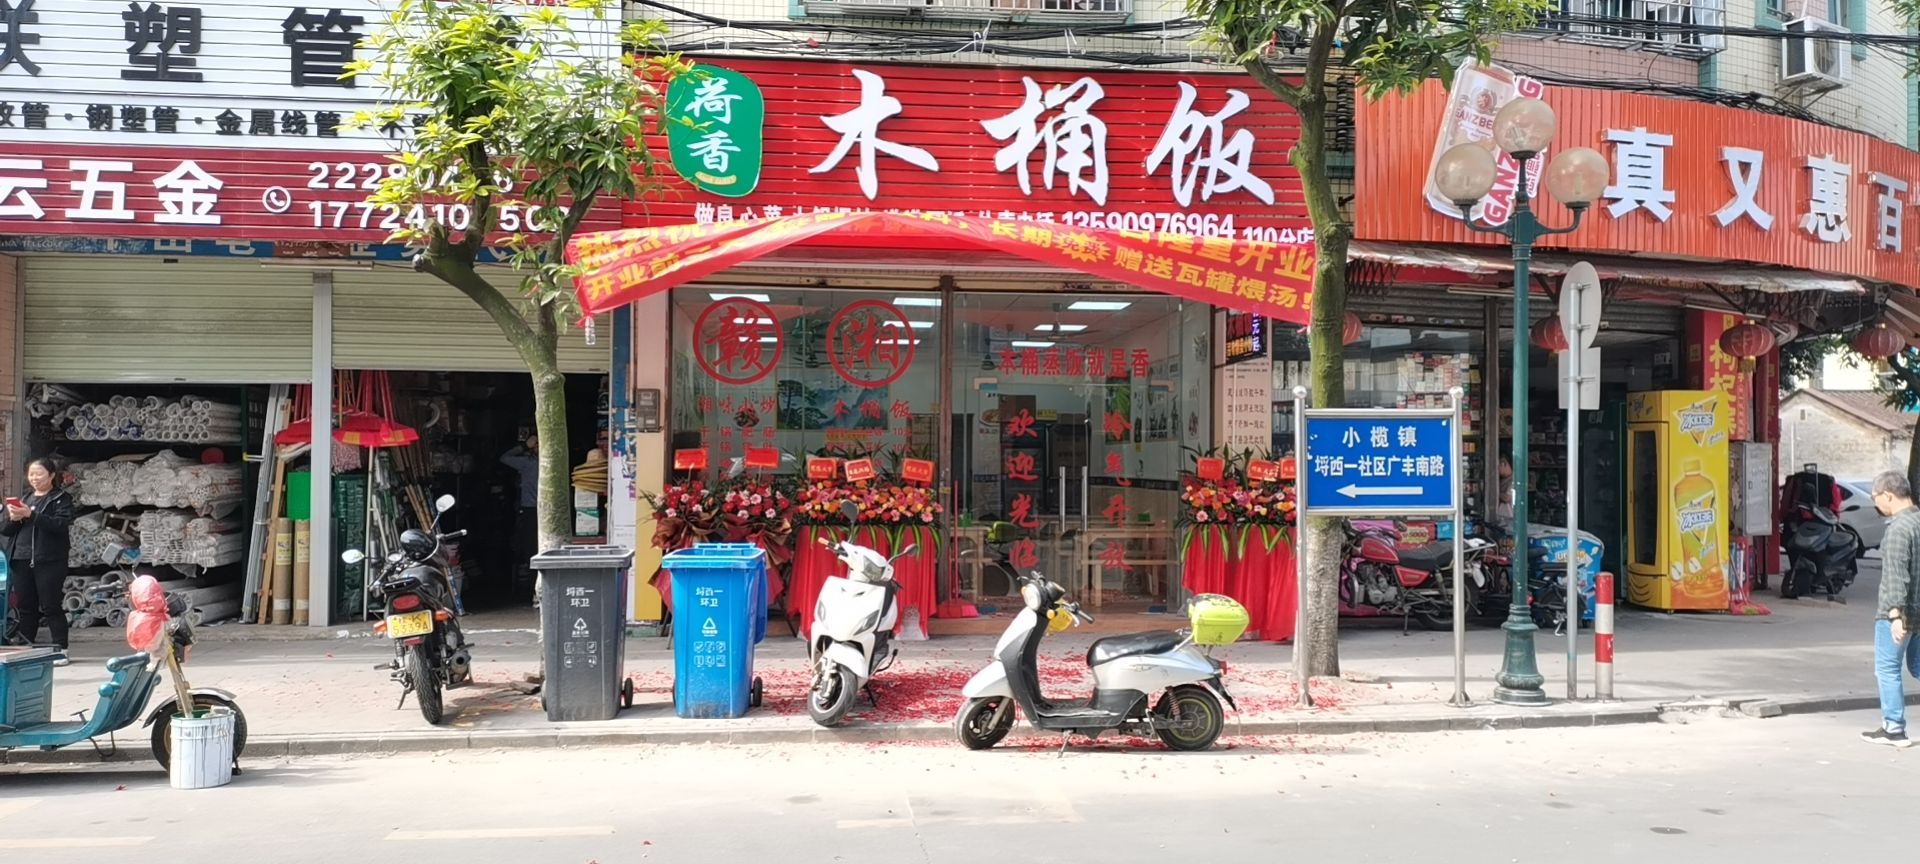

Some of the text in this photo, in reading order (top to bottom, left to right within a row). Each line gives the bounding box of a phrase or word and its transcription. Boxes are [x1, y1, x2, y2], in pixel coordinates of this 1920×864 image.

[684, 77, 743, 173] 荷香
[808, 68, 1276, 208] 木桶饭
[1483, 78, 1542, 224] GANZG
[1062, 211, 1236, 240] 13590976964
[1603, 127, 1908, 254] 真又惠百
[841, 312, 900, 371] 湘
[1314, 455, 1445, 477] 埒西一社区广丰南路
[1342, 425, 1417, 448] 小榄镇
[1007, 407, 1041, 570] 欢迎光临
